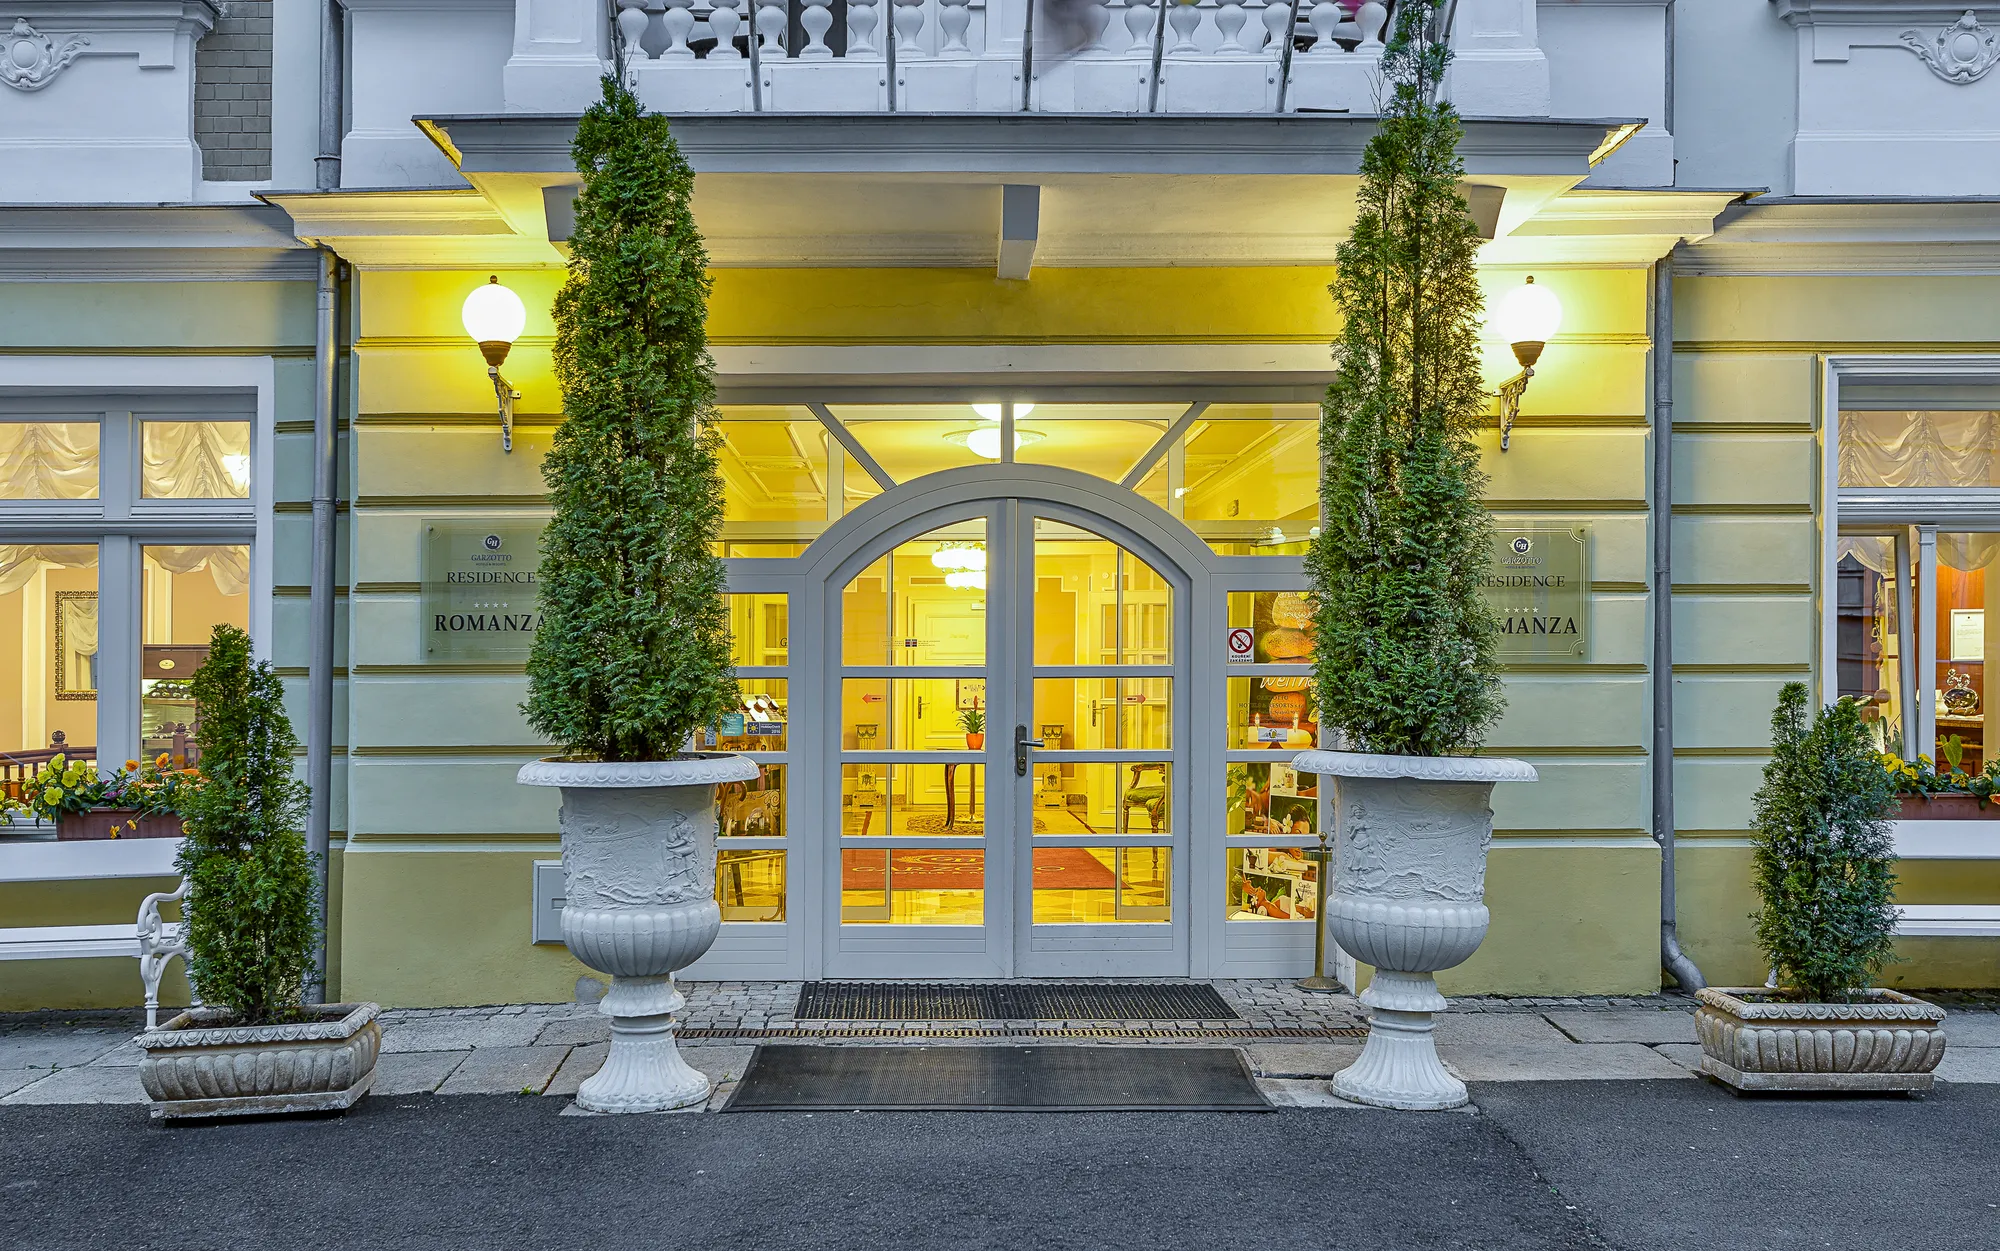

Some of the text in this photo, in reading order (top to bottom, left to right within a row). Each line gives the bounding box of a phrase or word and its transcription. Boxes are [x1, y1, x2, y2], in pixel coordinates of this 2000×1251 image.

[1515, 541, 1528, 550] GH
[1501, 557, 1543, 565] GARZOTTO
[447, 572, 536, 584] RESIDENCE
[1476, 575, 1565, 588] RESIDENCE
[434, 614, 545, 631] ROMANZA
[1499, 616, 1578, 634] MANZA
